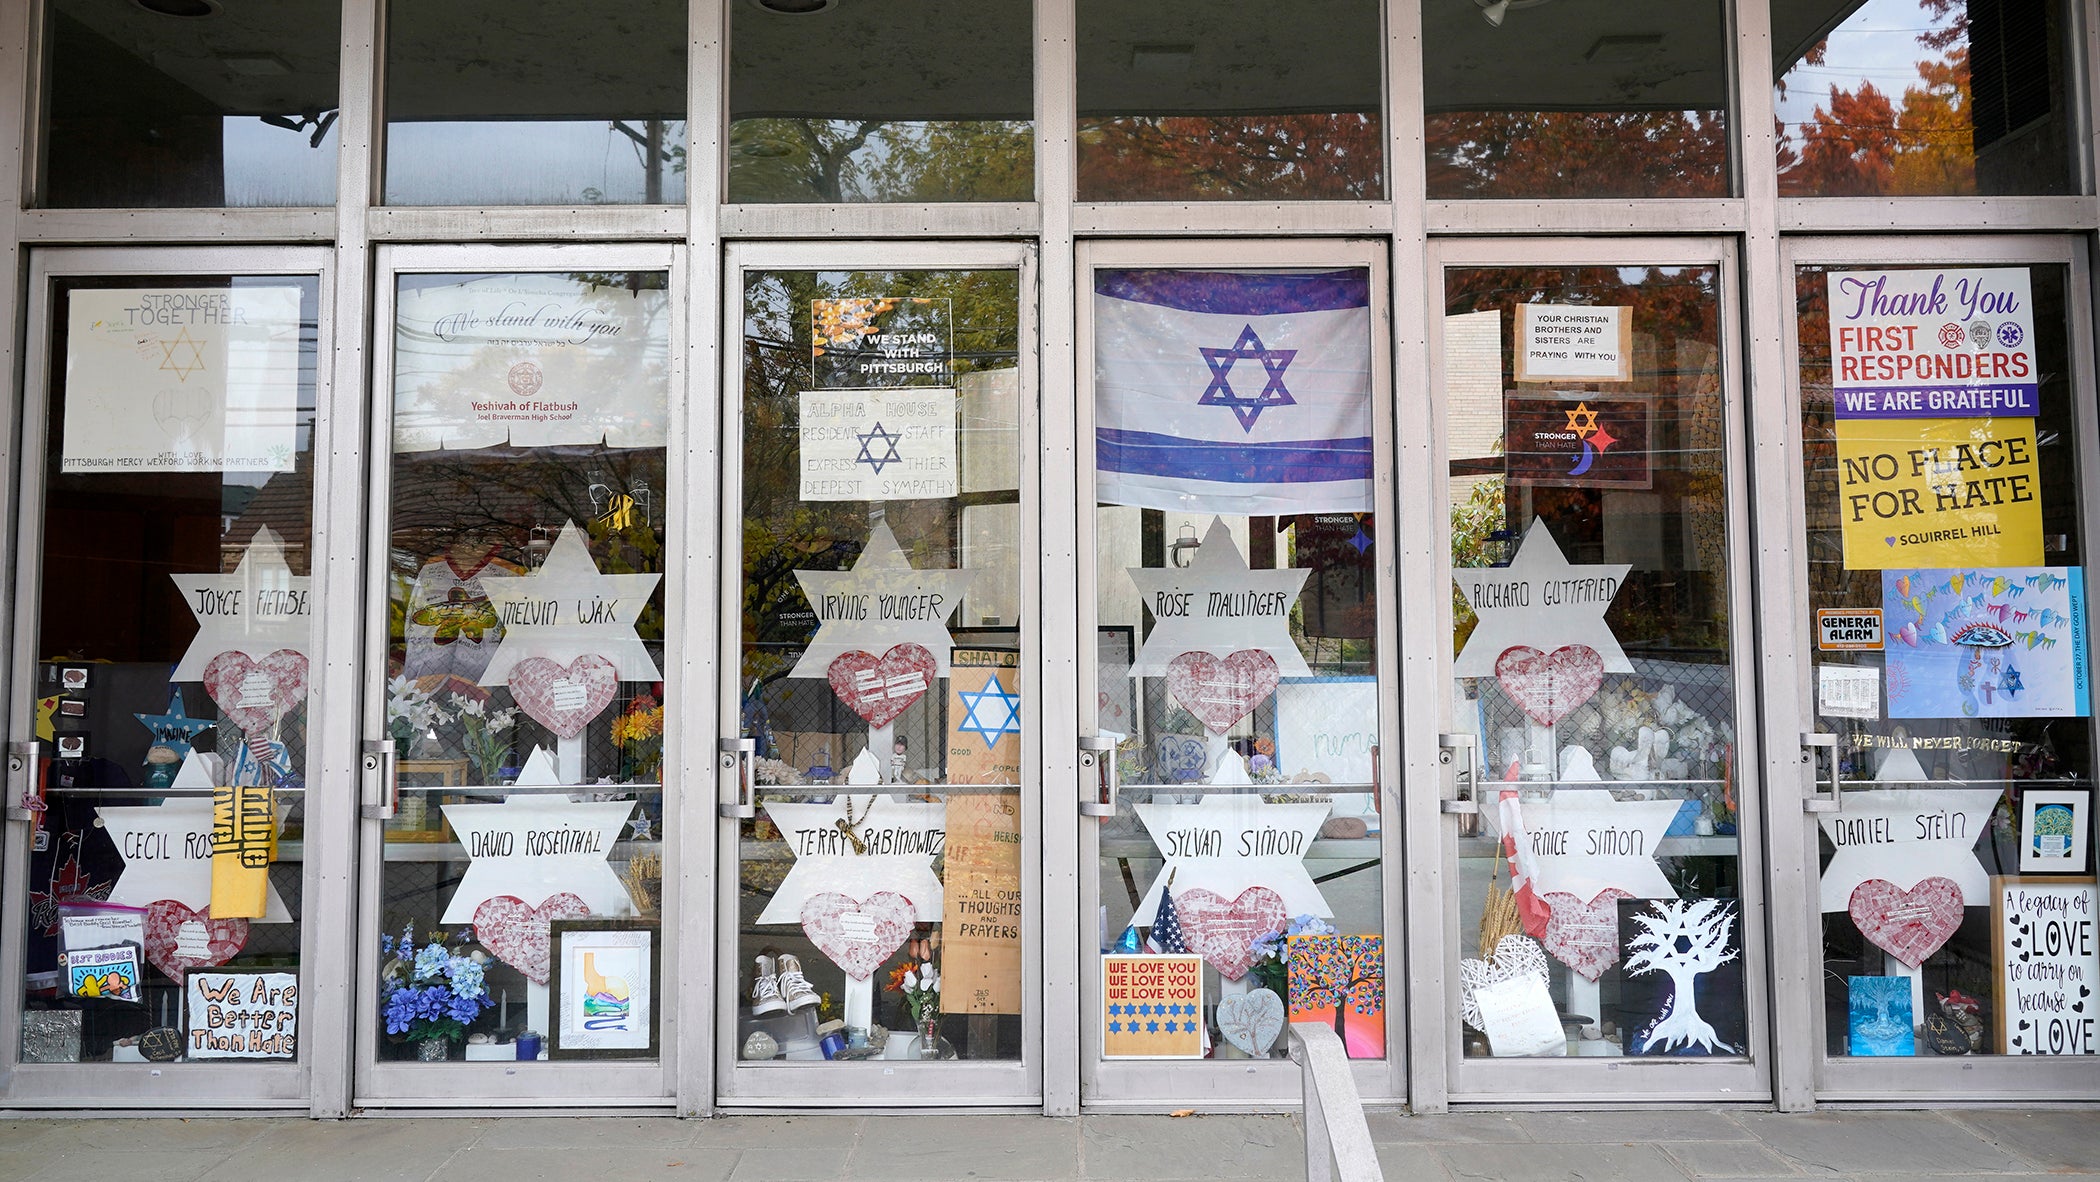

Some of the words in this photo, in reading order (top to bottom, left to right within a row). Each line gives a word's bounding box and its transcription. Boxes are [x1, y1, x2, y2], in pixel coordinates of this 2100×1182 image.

[140, 294, 229, 309] STRONGER
[1840, 274, 1948, 320] Thank
[1955, 277, 2020, 322] You
[124, 307, 248, 325] TOGETHER
[486, 302, 562, 327] stand
[544, 308, 604, 331] with
[1564, 315, 1609, 323] CHRISTIAN
[434, 310, 478, 342] We
[568, 322, 622, 345] you
[1535, 326, 1582, 334] BROTHERS
[1584, 326, 1602, 334] AND
[867, 335, 888, 344] WE
[892, 334, 936, 344] STAND
[1840, 326, 1918, 352] FIRST
[885, 350, 920, 359] WITH
[1530, 351, 1568, 359] PRAYING
[1574, 352, 1596, 360] WITH
[1598, 353, 1616, 361] YOU
[860, 363, 943, 374] PITTSBURGH
[1841, 352, 2029, 381] RESPONDERS
[471, 401, 516, 411] Yeshivah
[520, 401, 530, 411] of
[533, 401, 578, 411] Flatbush
[807, 402, 866, 417] ALPHA
[886, 402, 938, 417] HOUSE
[1845, 392, 1876, 411] WE
[1883, 391, 1922, 410] ARE
[1929, 389, 2030, 410] GRATEFUL
[532, 413, 548, 422] High
[905, 426, 944, 439] STAFF
[64, 458, 114, 467] PITTSBURGH
[117, 458, 143, 467] MERCY
[147, 458, 184, 466] WEXFORD
[187, 458, 222, 466] WORKING
[226, 458, 268, 466] PARTNERS
[158, 451, 178, 459] WITH
[808, 458, 857, 471] EXPRESS
[907, 457, 948, 470] THIER
[1843, 453, 1899, 486] NO
[1907, 437, 2030, 477] PLACE
[805, 481, 862, 494] DEEPEST
[881, 479, 955, 494] SYMPATHY
[1849, 488, 1924, 522] FOR
[1932, 474, 2033, 512] HATE
[1315, 516, 1354, 524] STRONGER
[1900, 528, 1967, 546] SQUIRREL
[1972, 524, 2001, 537] HILL
[195, 588, 242, 616] JOYCE
[503, 597, 558, 626] MELVIN
[578, 595, 618, 624] WAX
[821, 593, 869, 621] IRVING
[880, 592, 943, 621] YOUNGER
[1156, 591, 1194, 618] ROSE
[1208, 591, 1286, 618] MALLINGER
[1822, 617, 1879, 628] GENERAL
[1830, 629, 1873, 640] ALARM
[156, 728, 192, 743] IMAGINE
[1852, 734, 1872, 747] WE
[1876, 735, 1908, 749] WILL
[1912, 736, 1962, 750] NEVER
[1966, 736, 2021, 753] FORGET
[951, 748, 971, 756] GOOD
[1836, 817, 1894, 846] DANIEL
[1916, 812, 1966, 840] STEIN
[124, 831, 170, 860] CECIL
[471, 830, 514, 857] DAVID
[526, 828, 601, 857] ROSENTHAL
[796, 828, 847, 856] TERRY
[864, 826, 946, 856] RABINOWITZ
[1166, 828, 1222, 857] SYLVAN
[1238, 826, 1303, 857] SIMON
[1586, 826, 1643, 856] SIMON
[998, 890, 1022, 900] OUR
[2006, 891, 2014, 910] A
[2019, 890, 2069, 919] legacy
[2074, 889, 2090, 914] of
[959, 901, 1022, 915] THOUGHTS
[960, 924, 1017, 939] PRAYERS
[2032, 921, 2092, 956] LOVE
[70, 954, 93, 965] BEST
[94, 950, 133, 963] BUDDIES
[1109, 963, 1127, 973] WE
[1132, 963, 1164, 973] LOVE
[1168, 963, 1196, 973] YOU
[2008, 961, 2023, 982] to
[2027, 962, 2065, 989] carry
[2068, 964, 2084, 981] on
[1109, 976, 1127, 986] WE
[1132, 976, 1164, 986] LOVE
[1168, 976, 1196, 986] YOU
[198, 976, 242, 1005] We
[251, 976, 297, 1007] Are
[1109, 989, 1127, 999] WE
[1132, 989, 1164, 999] LOVE
[1168, 989, 1196, 999] YOU
[1664, 994, 1674, 1008] you
[2017, 988, 2067, 1014] because
[207, 1004, 293, 1031] Better
[191, 1029, 245, 1052] Than
[248, 1030, 296, 1054] Hate
[2035, 1018, 2095, 1055] LOVE
